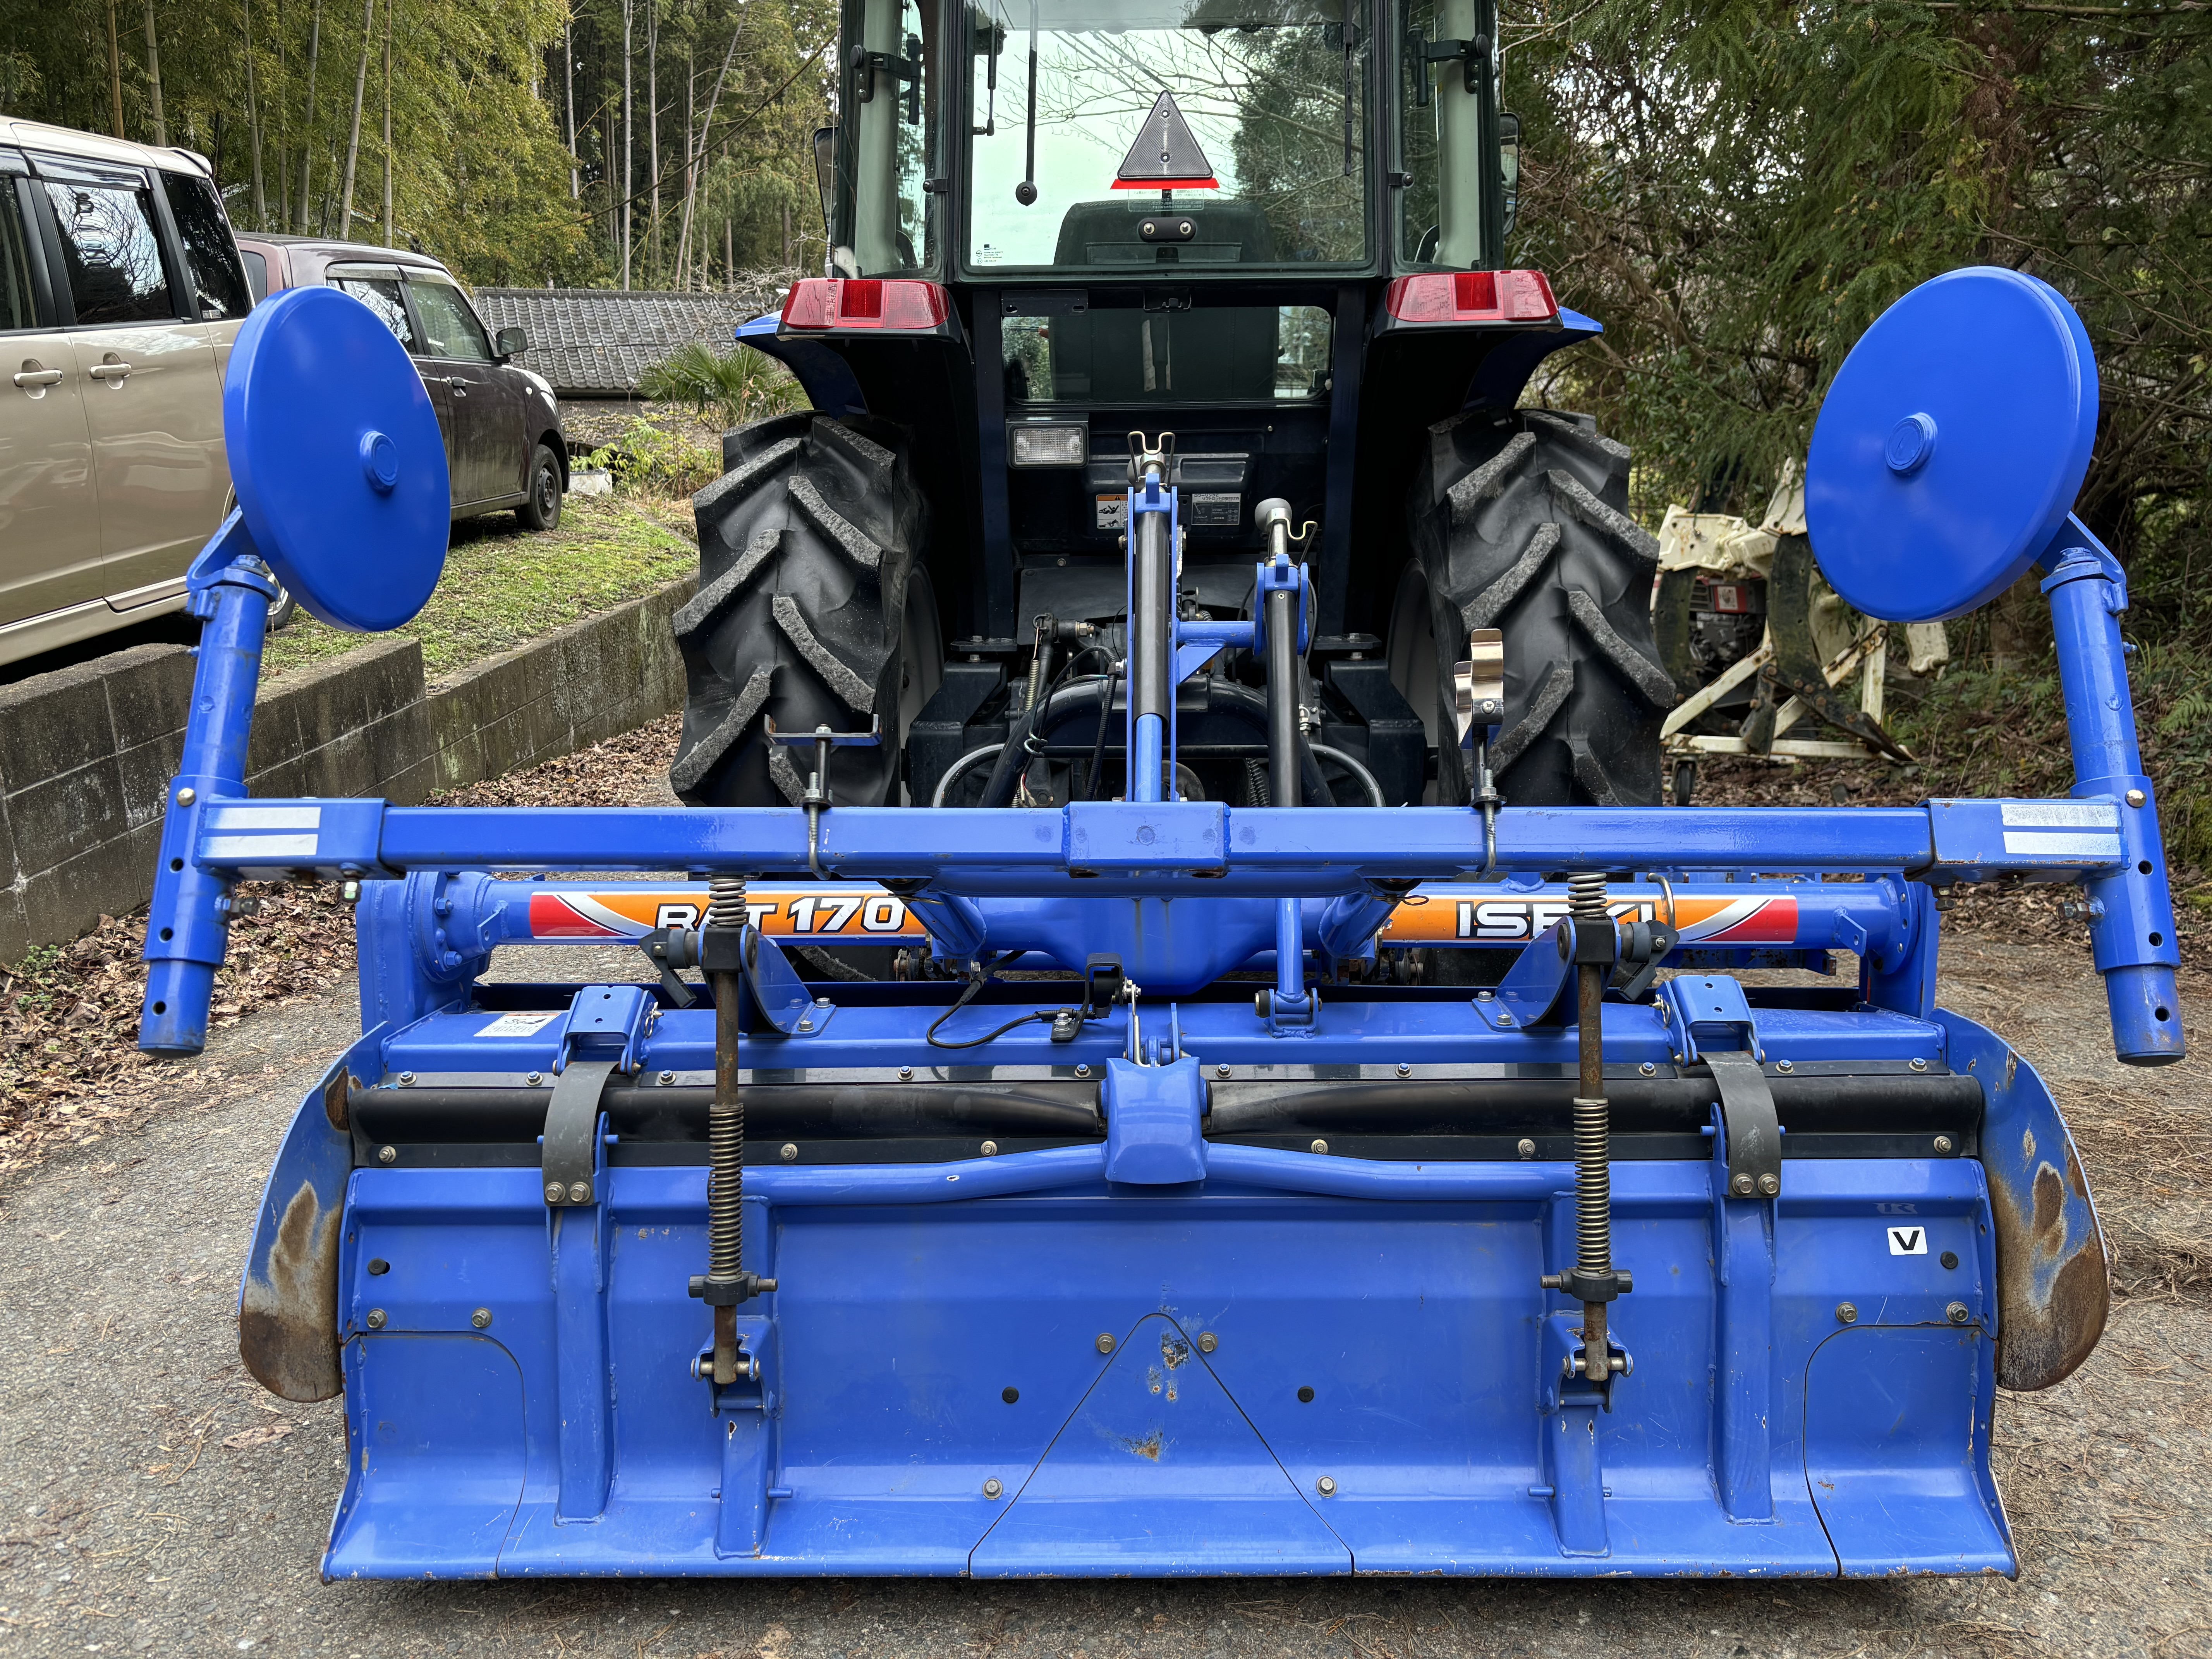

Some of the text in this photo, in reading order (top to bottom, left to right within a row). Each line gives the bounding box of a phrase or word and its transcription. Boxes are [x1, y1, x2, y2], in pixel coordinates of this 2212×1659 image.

[787, 895, 907, 933] 170
[1456, 901, 1656, 939] ISEI
[1892, 1230, 1920, 1251] V
